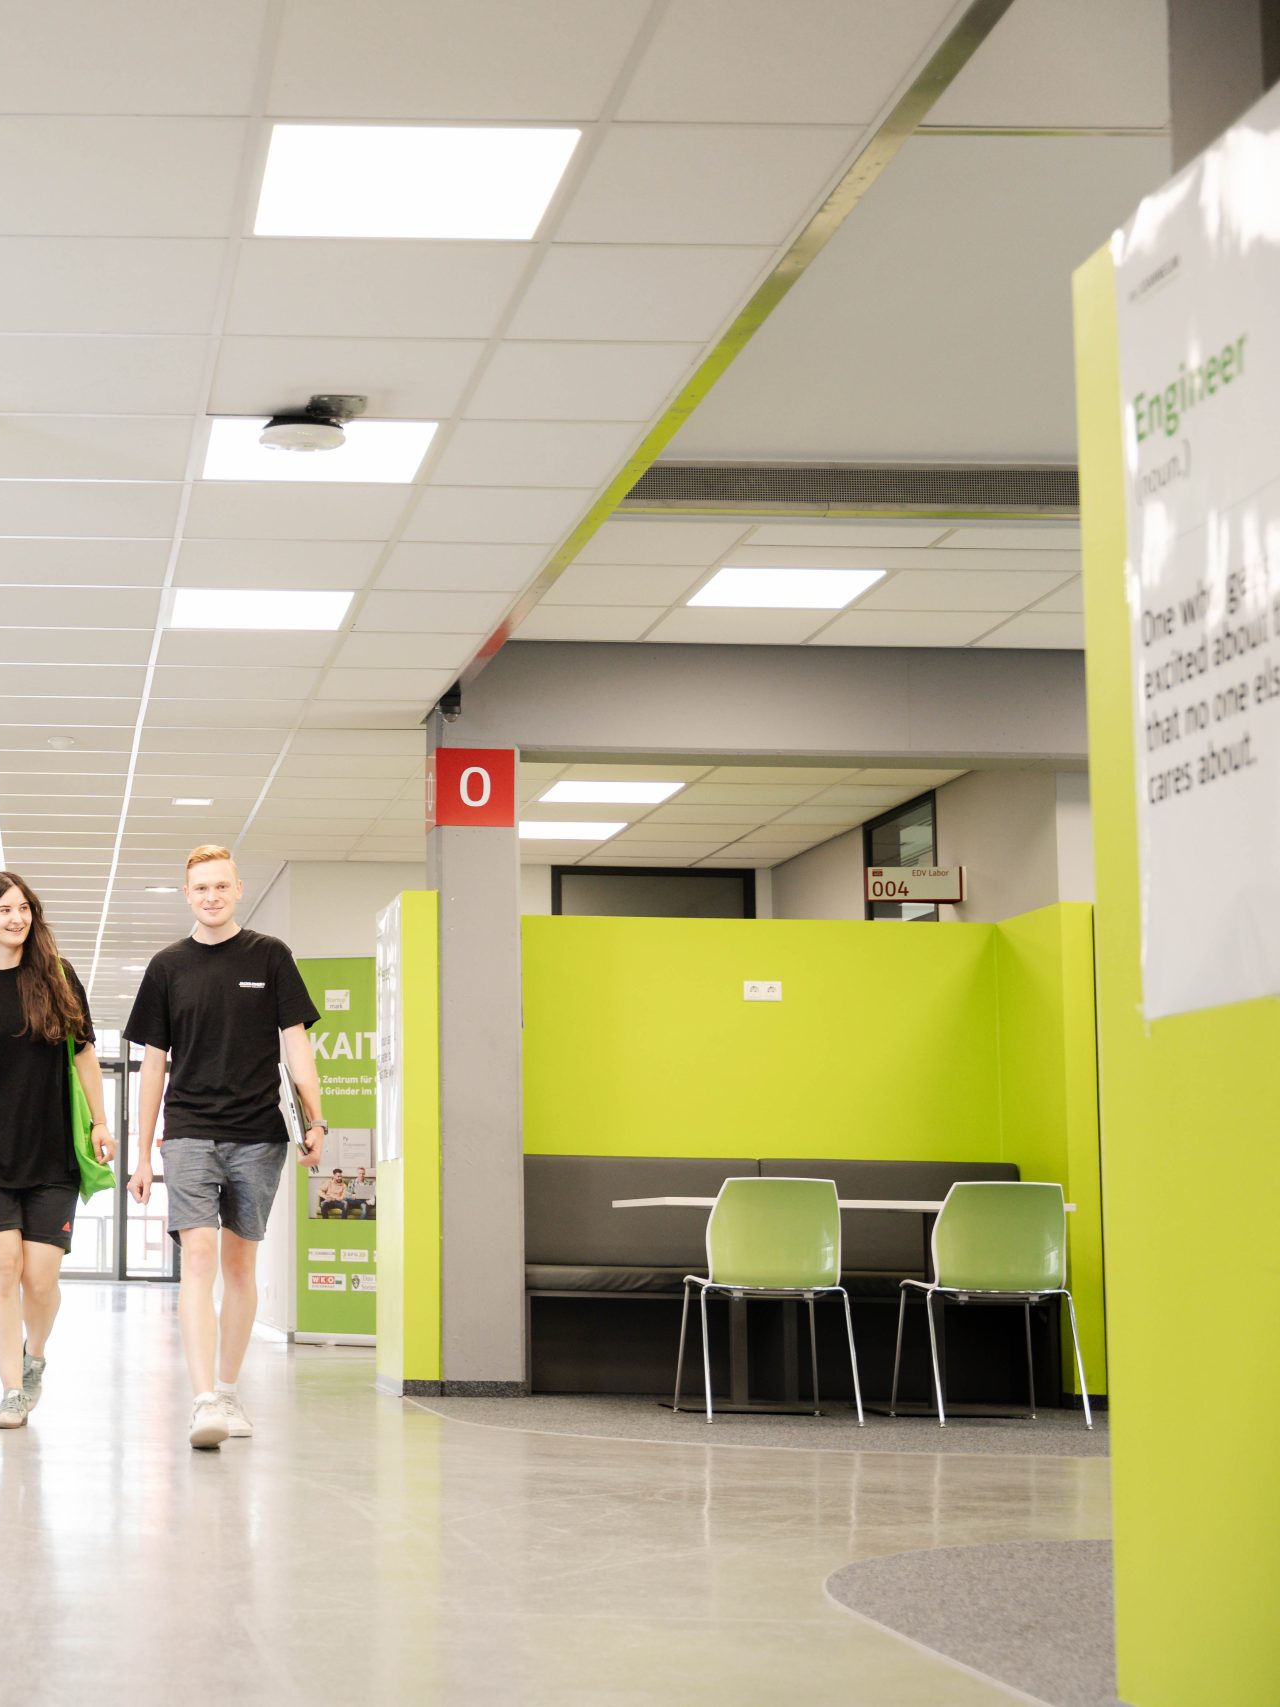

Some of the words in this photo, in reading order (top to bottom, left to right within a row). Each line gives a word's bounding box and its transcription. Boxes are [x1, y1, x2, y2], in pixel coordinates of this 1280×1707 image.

[1133, 333, 1247, 443] Engineer
[1142, 607, 1176, 646] One
[1147, 707, 1181, 752] that
[1185, 699, 1210, 736] no
[1213, 681, 1250, 723] one
[1148, 761, 1193, 805] cares
[911, 869, 928, 877] EDV
[928, 869, 949, 877] Labor
[872, 881, 909, 897] 004
[322, 1075, 359, 1084] Zentrum
[360, 1075, 373, 1084] für
[325, 1087, 359, 1096] Gründer
[362, 1087, 372, 1096] im
[312, 1276, 335, 1284] WKO
